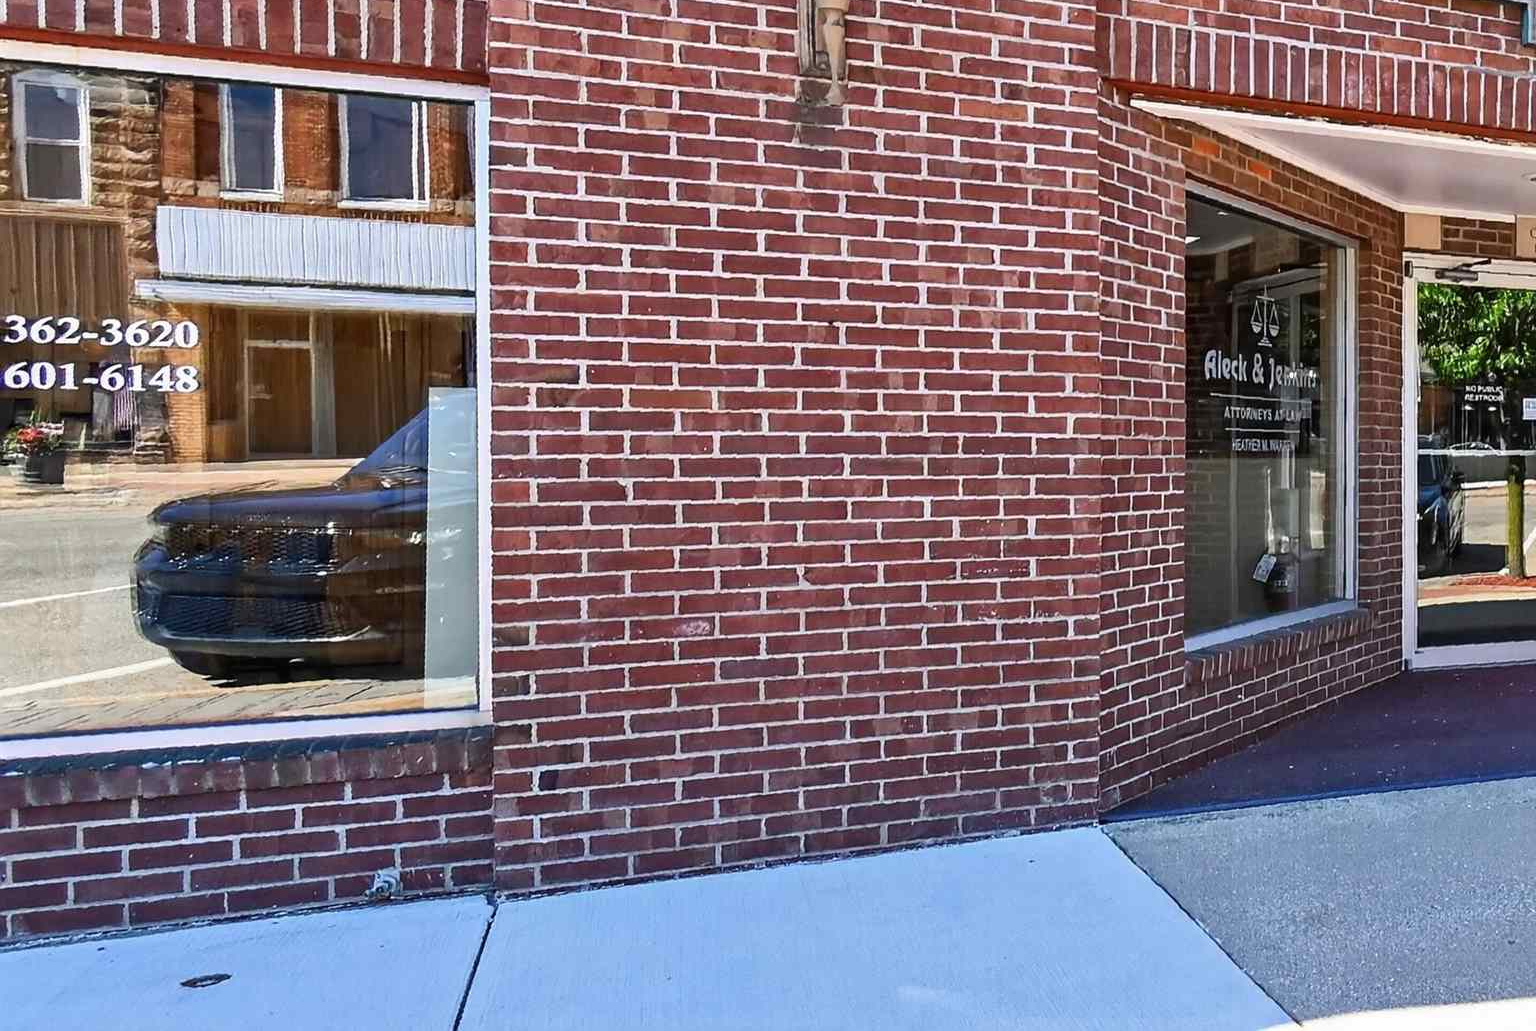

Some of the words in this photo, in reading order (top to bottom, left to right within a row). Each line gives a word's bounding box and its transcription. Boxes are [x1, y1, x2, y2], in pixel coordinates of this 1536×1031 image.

[4, 315, 199, 348] 362-3620
[4, 362, 199, 392] 601-6148
[1204, 349, 1248, 382] Aleck
[1251, 353, 1265, 384] &
[1224, 406, 1272, 421] ATTORNEYS
[1274, 410, 1284, 421] AT
